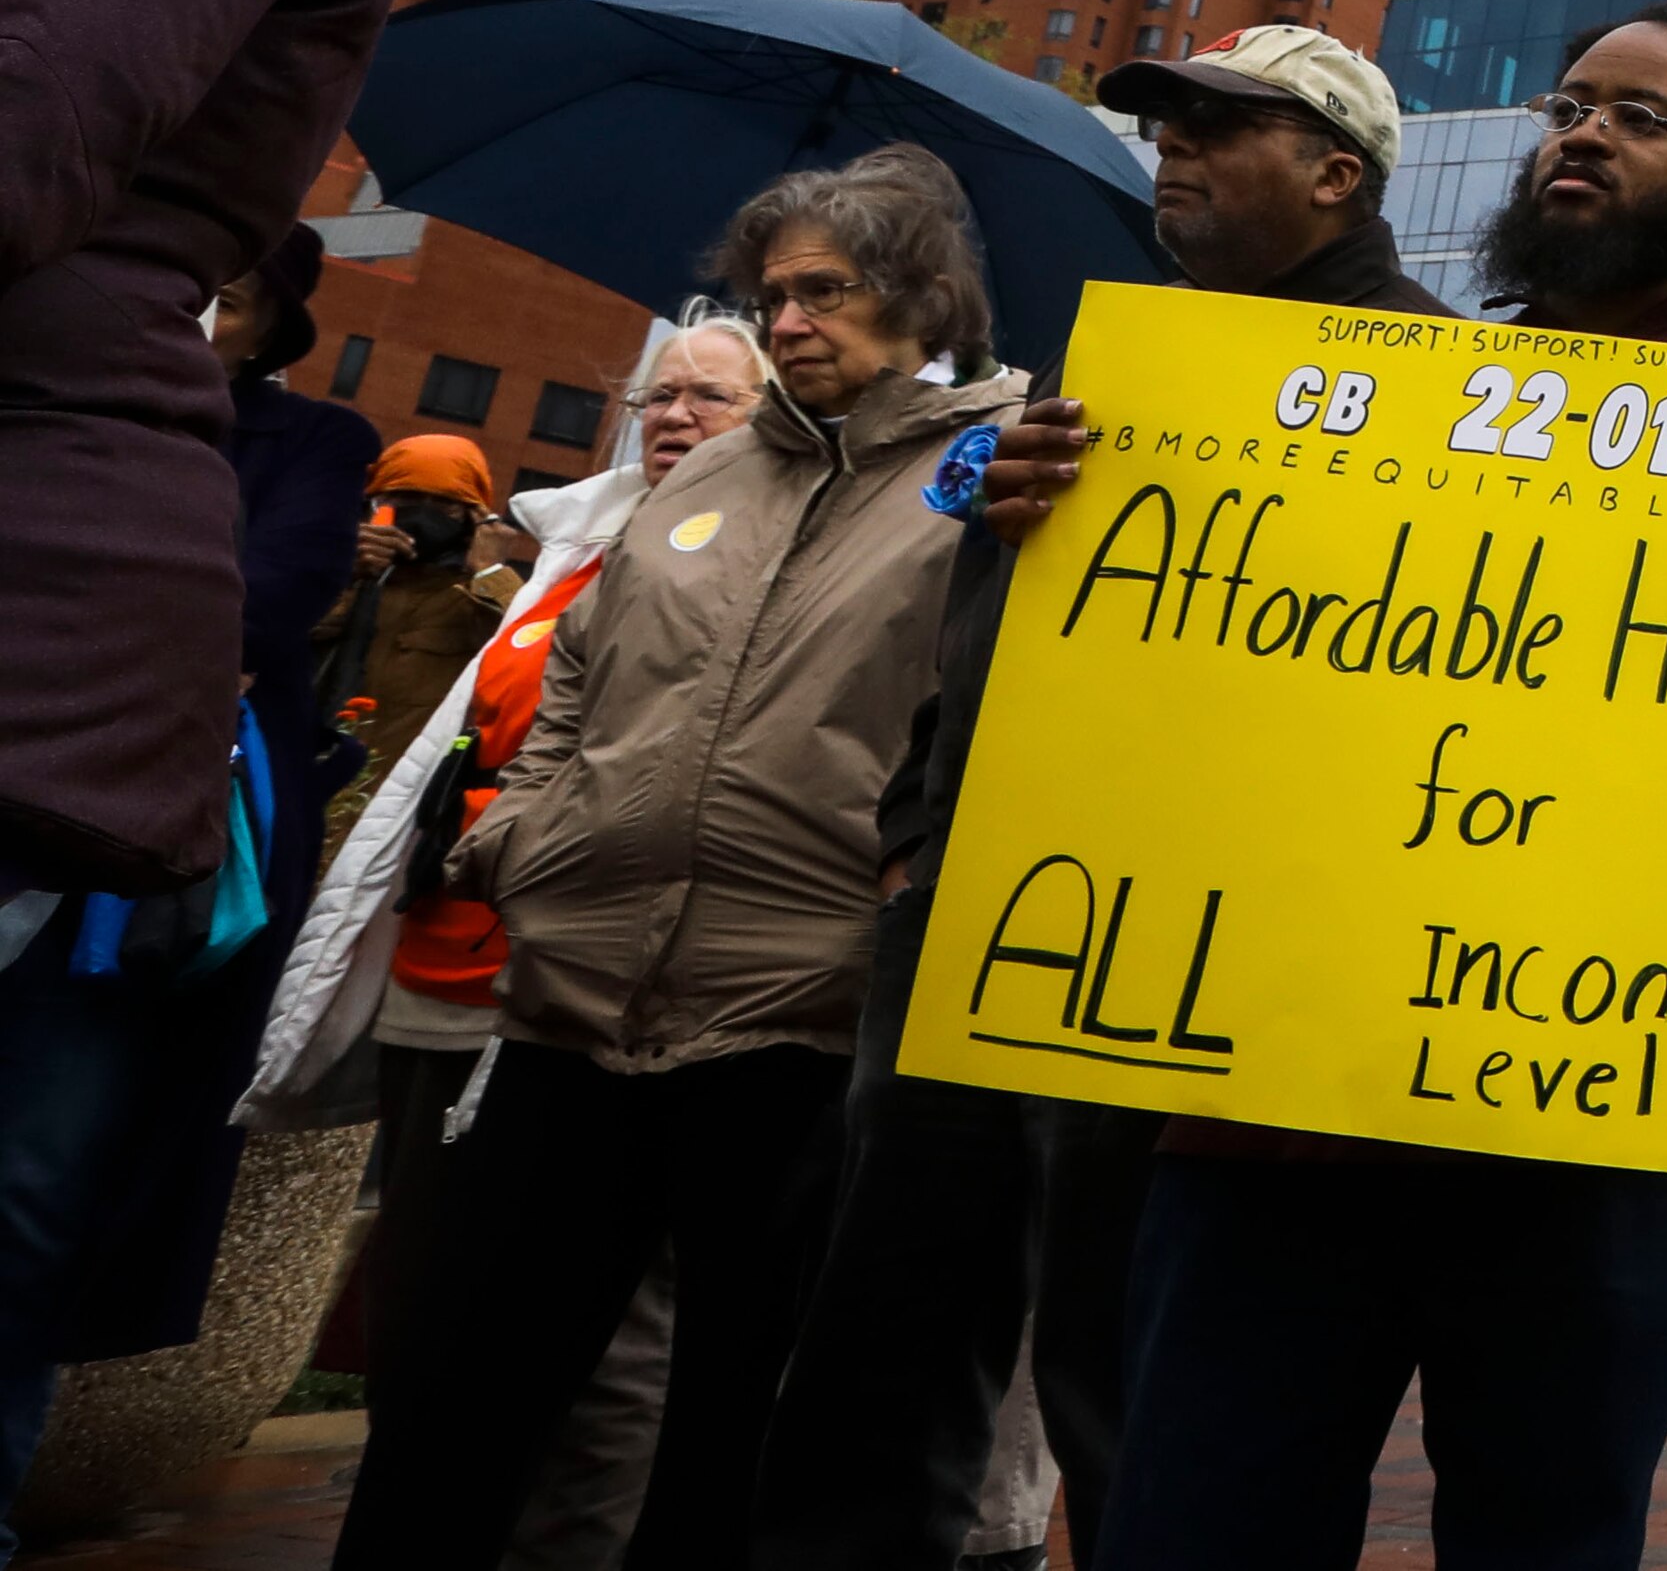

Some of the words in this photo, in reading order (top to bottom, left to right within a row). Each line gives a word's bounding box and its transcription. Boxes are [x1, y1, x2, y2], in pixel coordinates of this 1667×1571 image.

[1319, 315, 1459, 350] SUPPORT!
[1473, 329, 1618, 360] SUPPORT!
[1275, 365, 1377, 437] CB
[1060, 483, 1563, 689] Affordable
[1403, 723, 1556, 849] for
[969, 854, 1234, 1053] ALL
